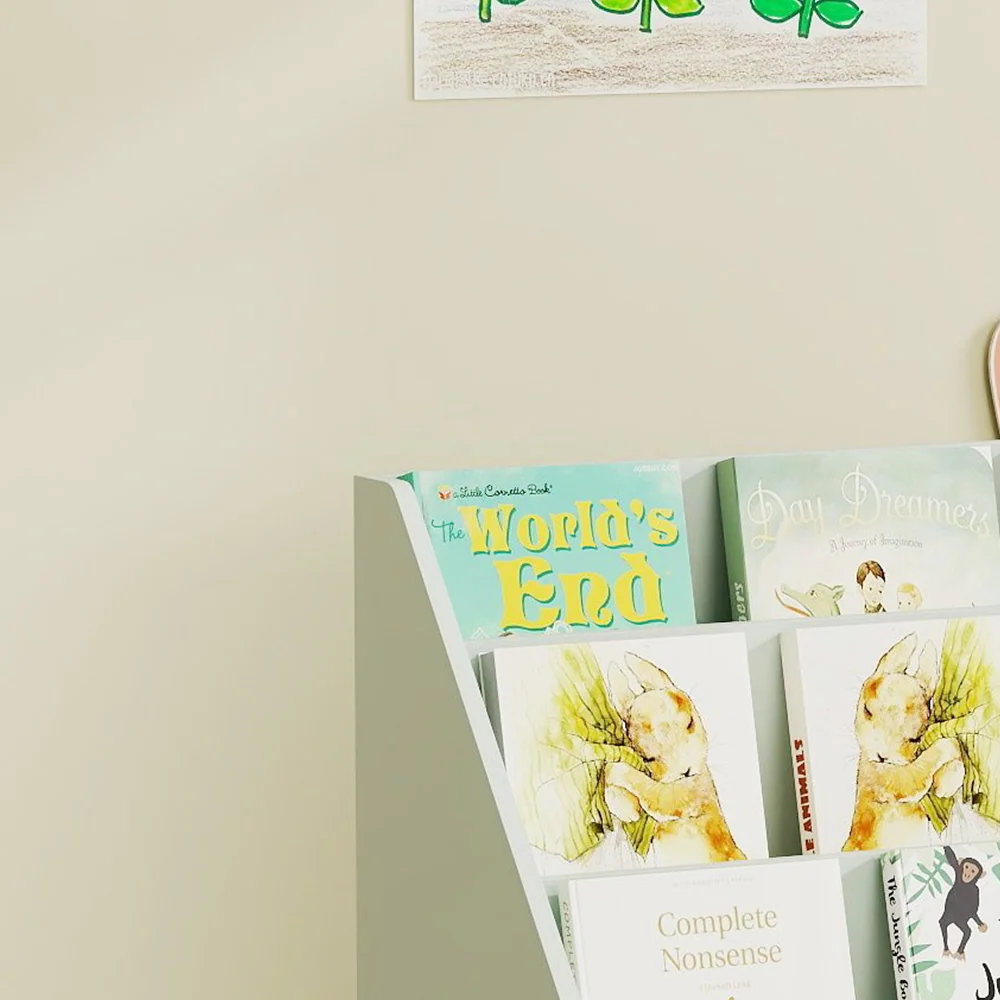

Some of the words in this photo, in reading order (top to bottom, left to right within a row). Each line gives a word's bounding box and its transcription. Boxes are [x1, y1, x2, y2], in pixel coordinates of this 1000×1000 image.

[459, 485, 484, 499] Little
[746, 479, 825, 550] Day
[838, 463, 991, 539] Dreamers
[431, 518, 466, 543] The
[457, 498, 680, 556] World's
[493, 552, 669, 632] End
[794, 738, 814, 834] ANIMALS
[886, 875, 897, 906] The
[657, 906, 778, 940] Complete
[890, 911, 907, 975] Jungle
[660, 944, 783, 973] Nonsense
